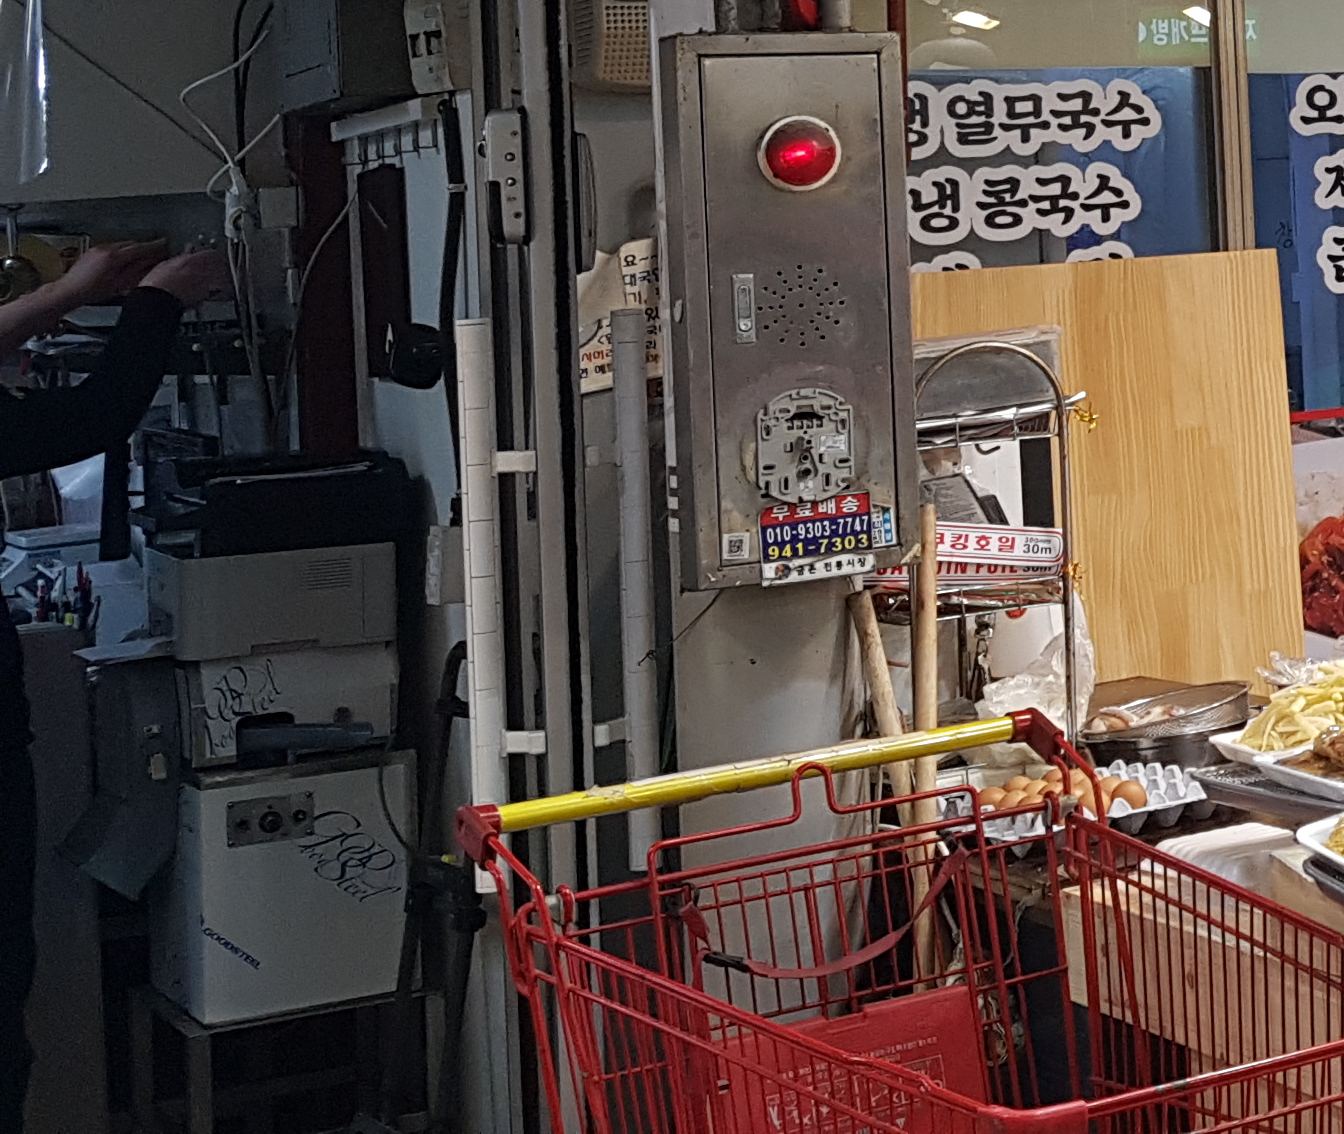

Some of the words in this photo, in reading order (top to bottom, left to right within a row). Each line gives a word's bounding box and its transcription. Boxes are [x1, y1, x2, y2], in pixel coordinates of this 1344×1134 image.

[946, 88, 1153, 146] 열무국수
[975, 172, 1131, 229] 콩국수
[770, 496, 861, 522] 무료배송
[766, 516, 869, 544] 010-9303-7747
[768, 533, 869, 560] 941-7303
[1023, 543, 1052, 556] 30m
